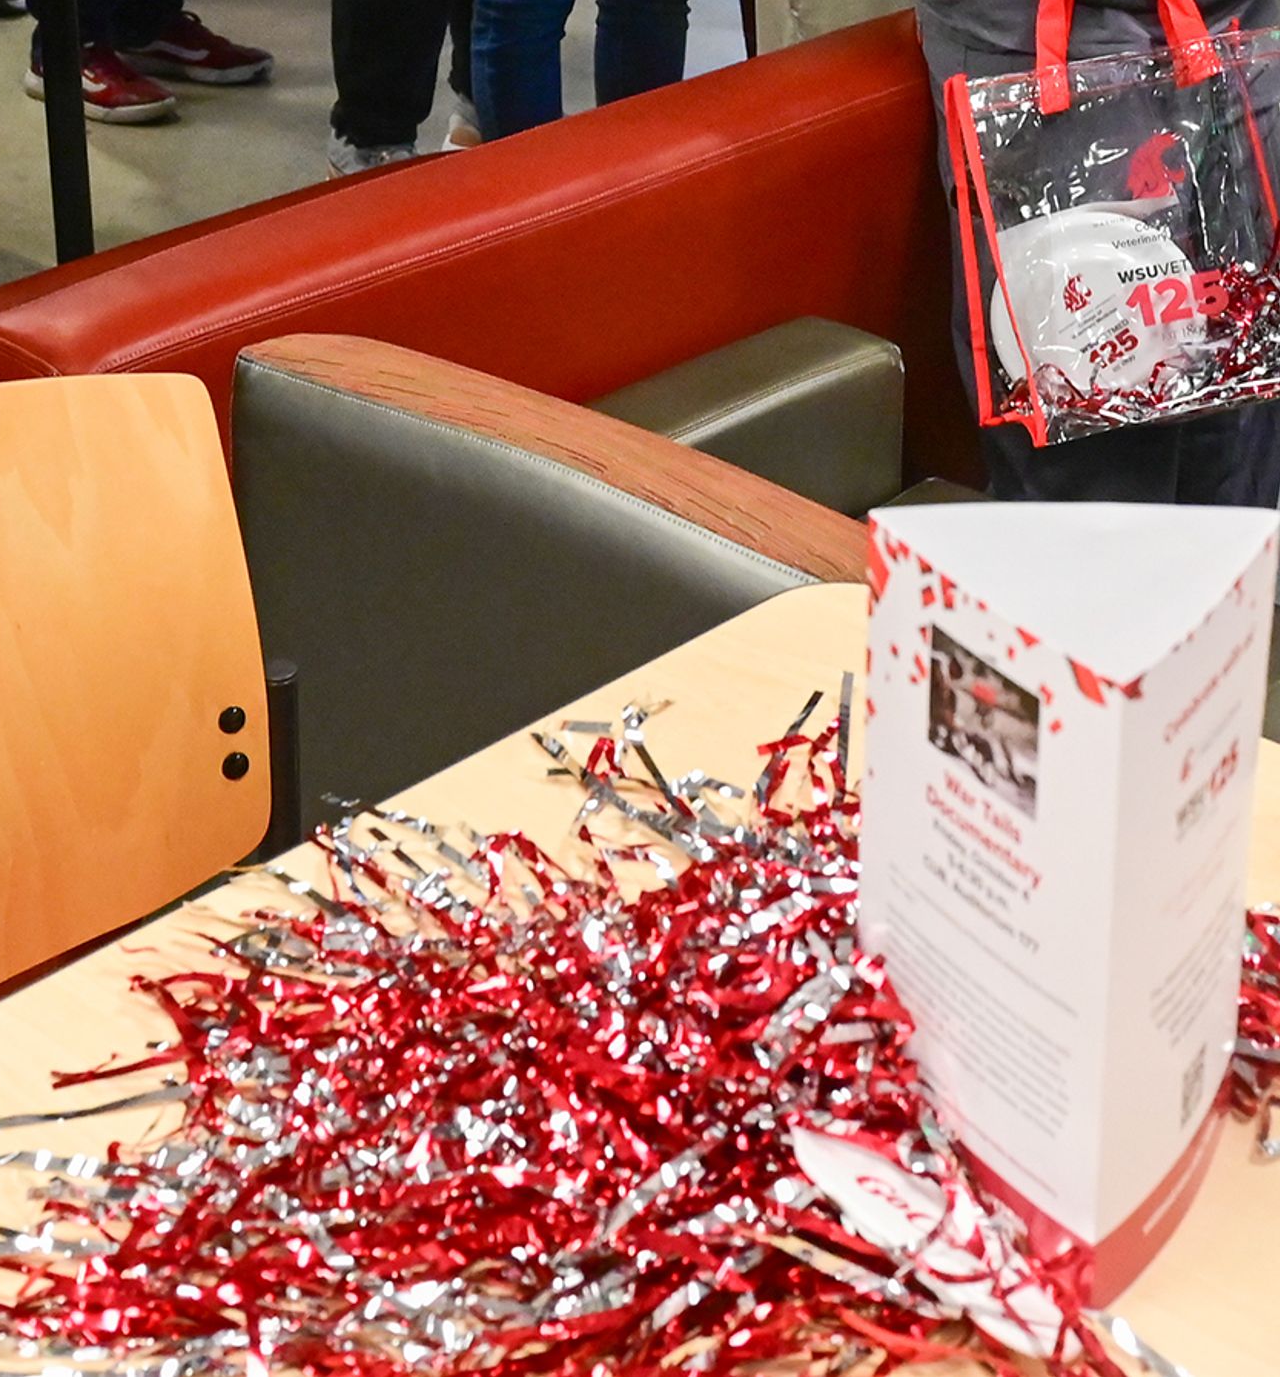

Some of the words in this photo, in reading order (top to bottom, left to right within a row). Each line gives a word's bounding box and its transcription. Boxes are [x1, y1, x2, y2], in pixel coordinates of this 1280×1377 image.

[1111, 231, 1168, 250] Veterinary
[1126, 269, 1229, 328] 125
[1089, 328, 1139, 369] 125
[926, 783, 1042, 889] Documentary
